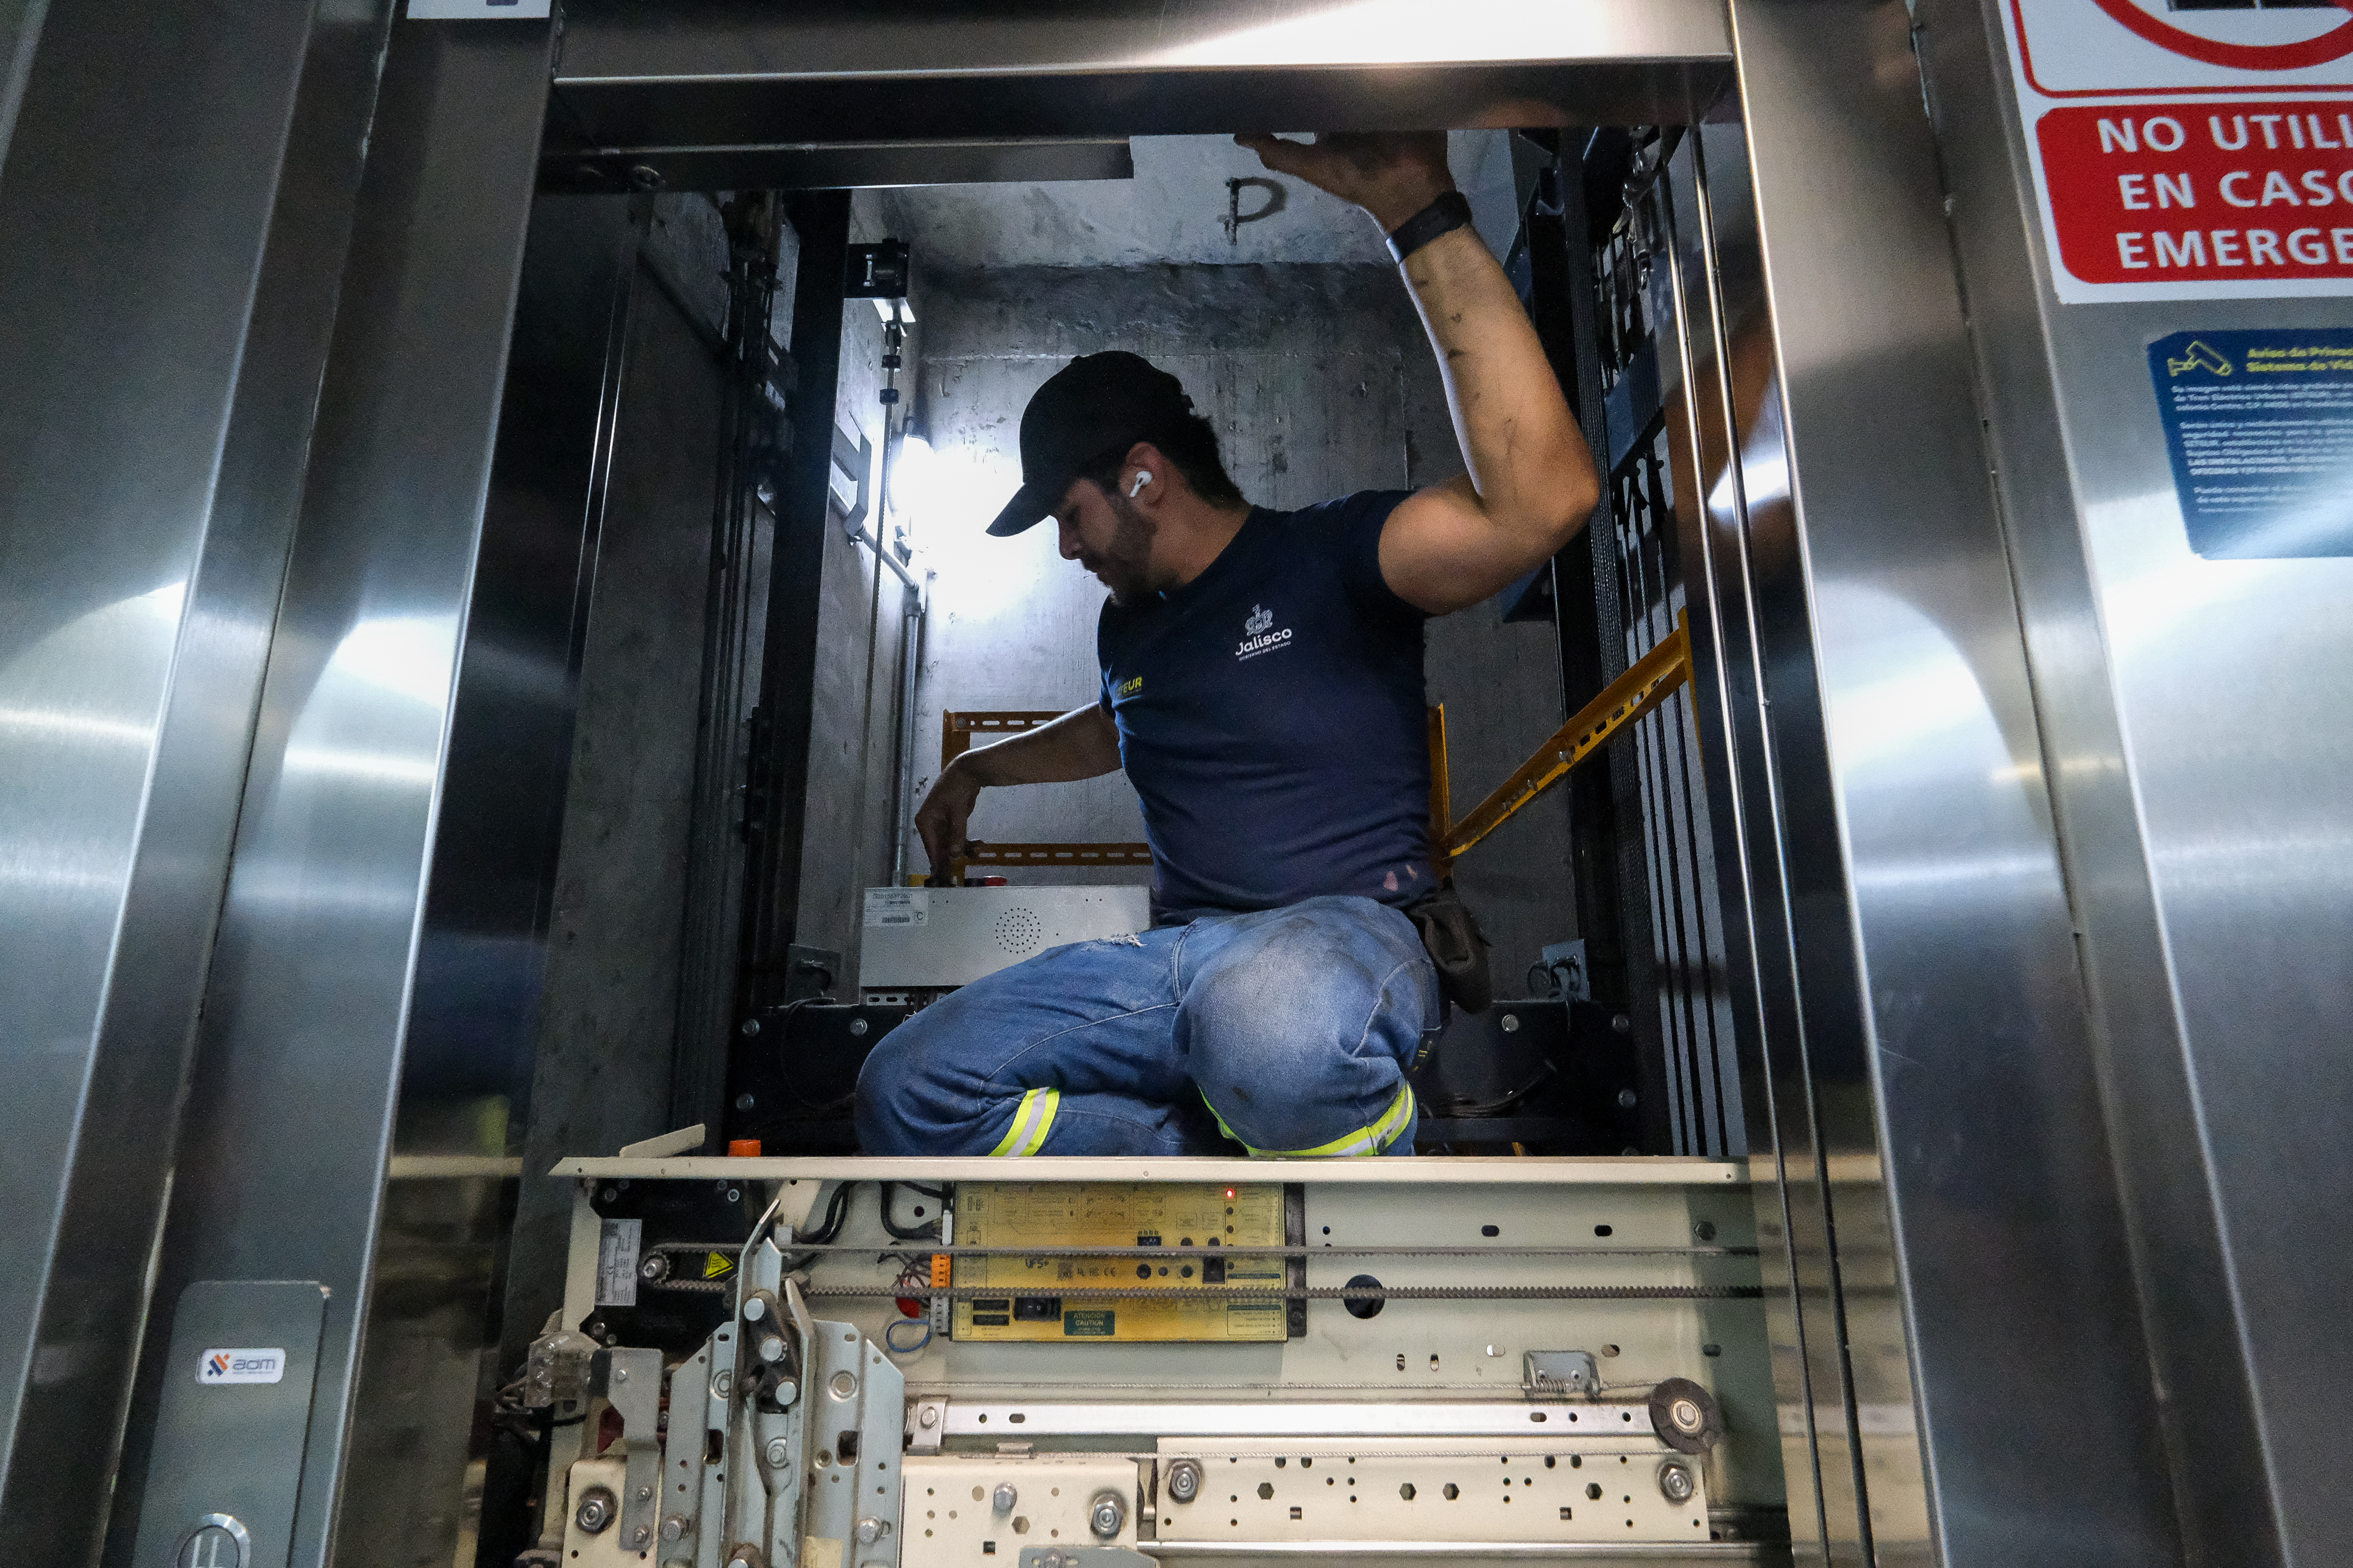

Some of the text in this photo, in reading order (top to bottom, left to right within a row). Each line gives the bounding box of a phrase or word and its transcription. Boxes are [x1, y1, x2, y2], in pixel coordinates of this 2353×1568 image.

[2096, 116, 2186, 153] NO
[2117, 172, 2196, 210] EN
[1235, 628, 1292, 656] Jalisco
